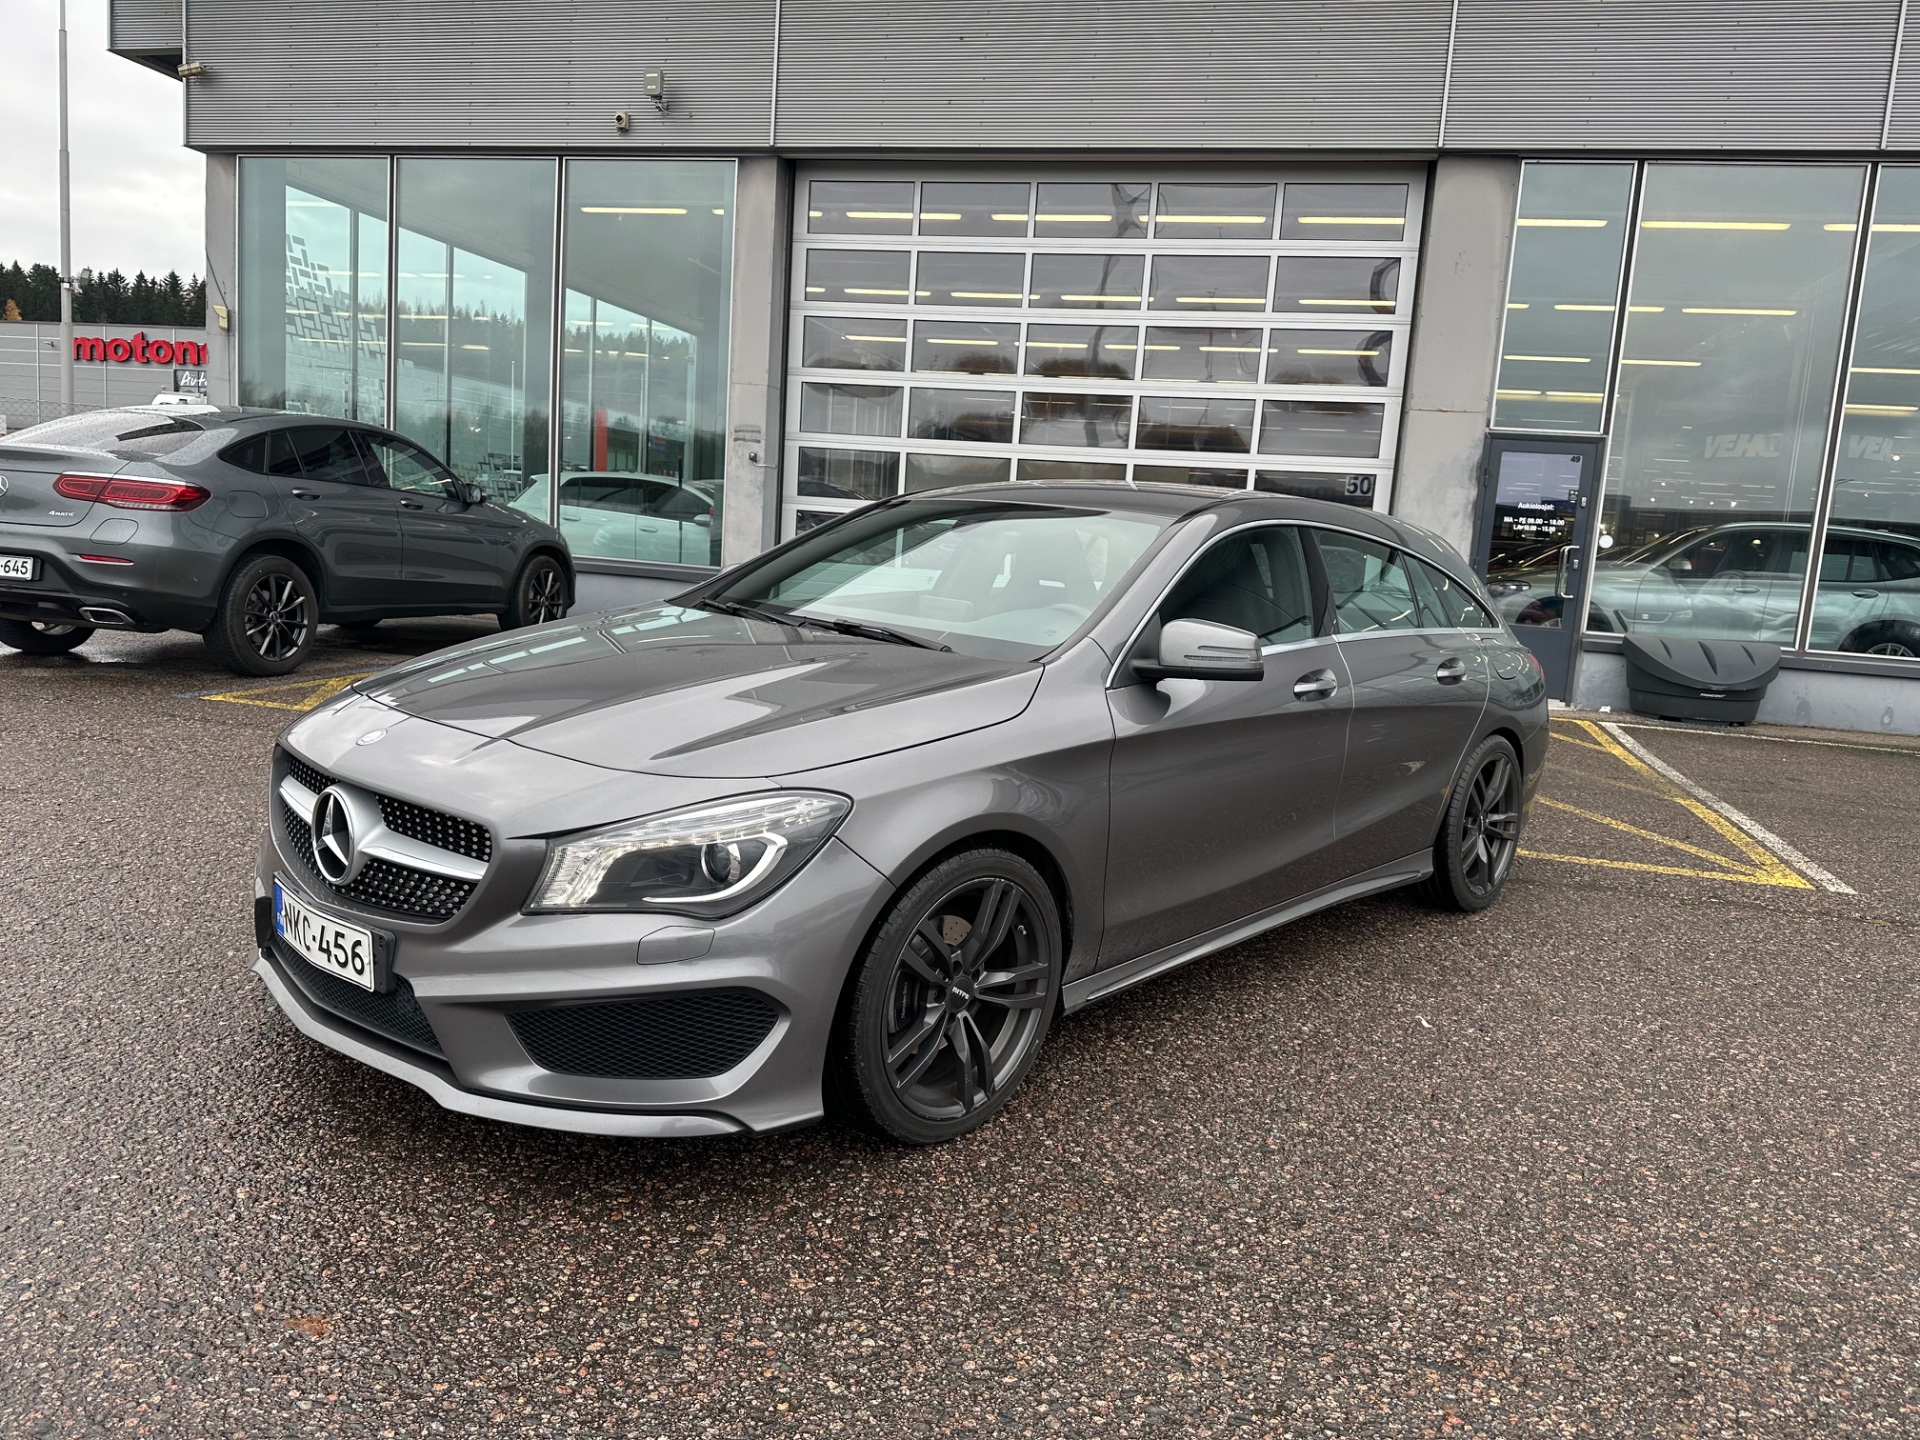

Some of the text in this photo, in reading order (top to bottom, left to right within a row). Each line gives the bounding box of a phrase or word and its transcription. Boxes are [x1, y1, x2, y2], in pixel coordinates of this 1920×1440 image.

[180, 371, 207, 386] Aut
[1570, 455, 1581, 463] 49
[1346, 476, 1372, 495] 50
[283, 898, 365, 976] NKC-456
